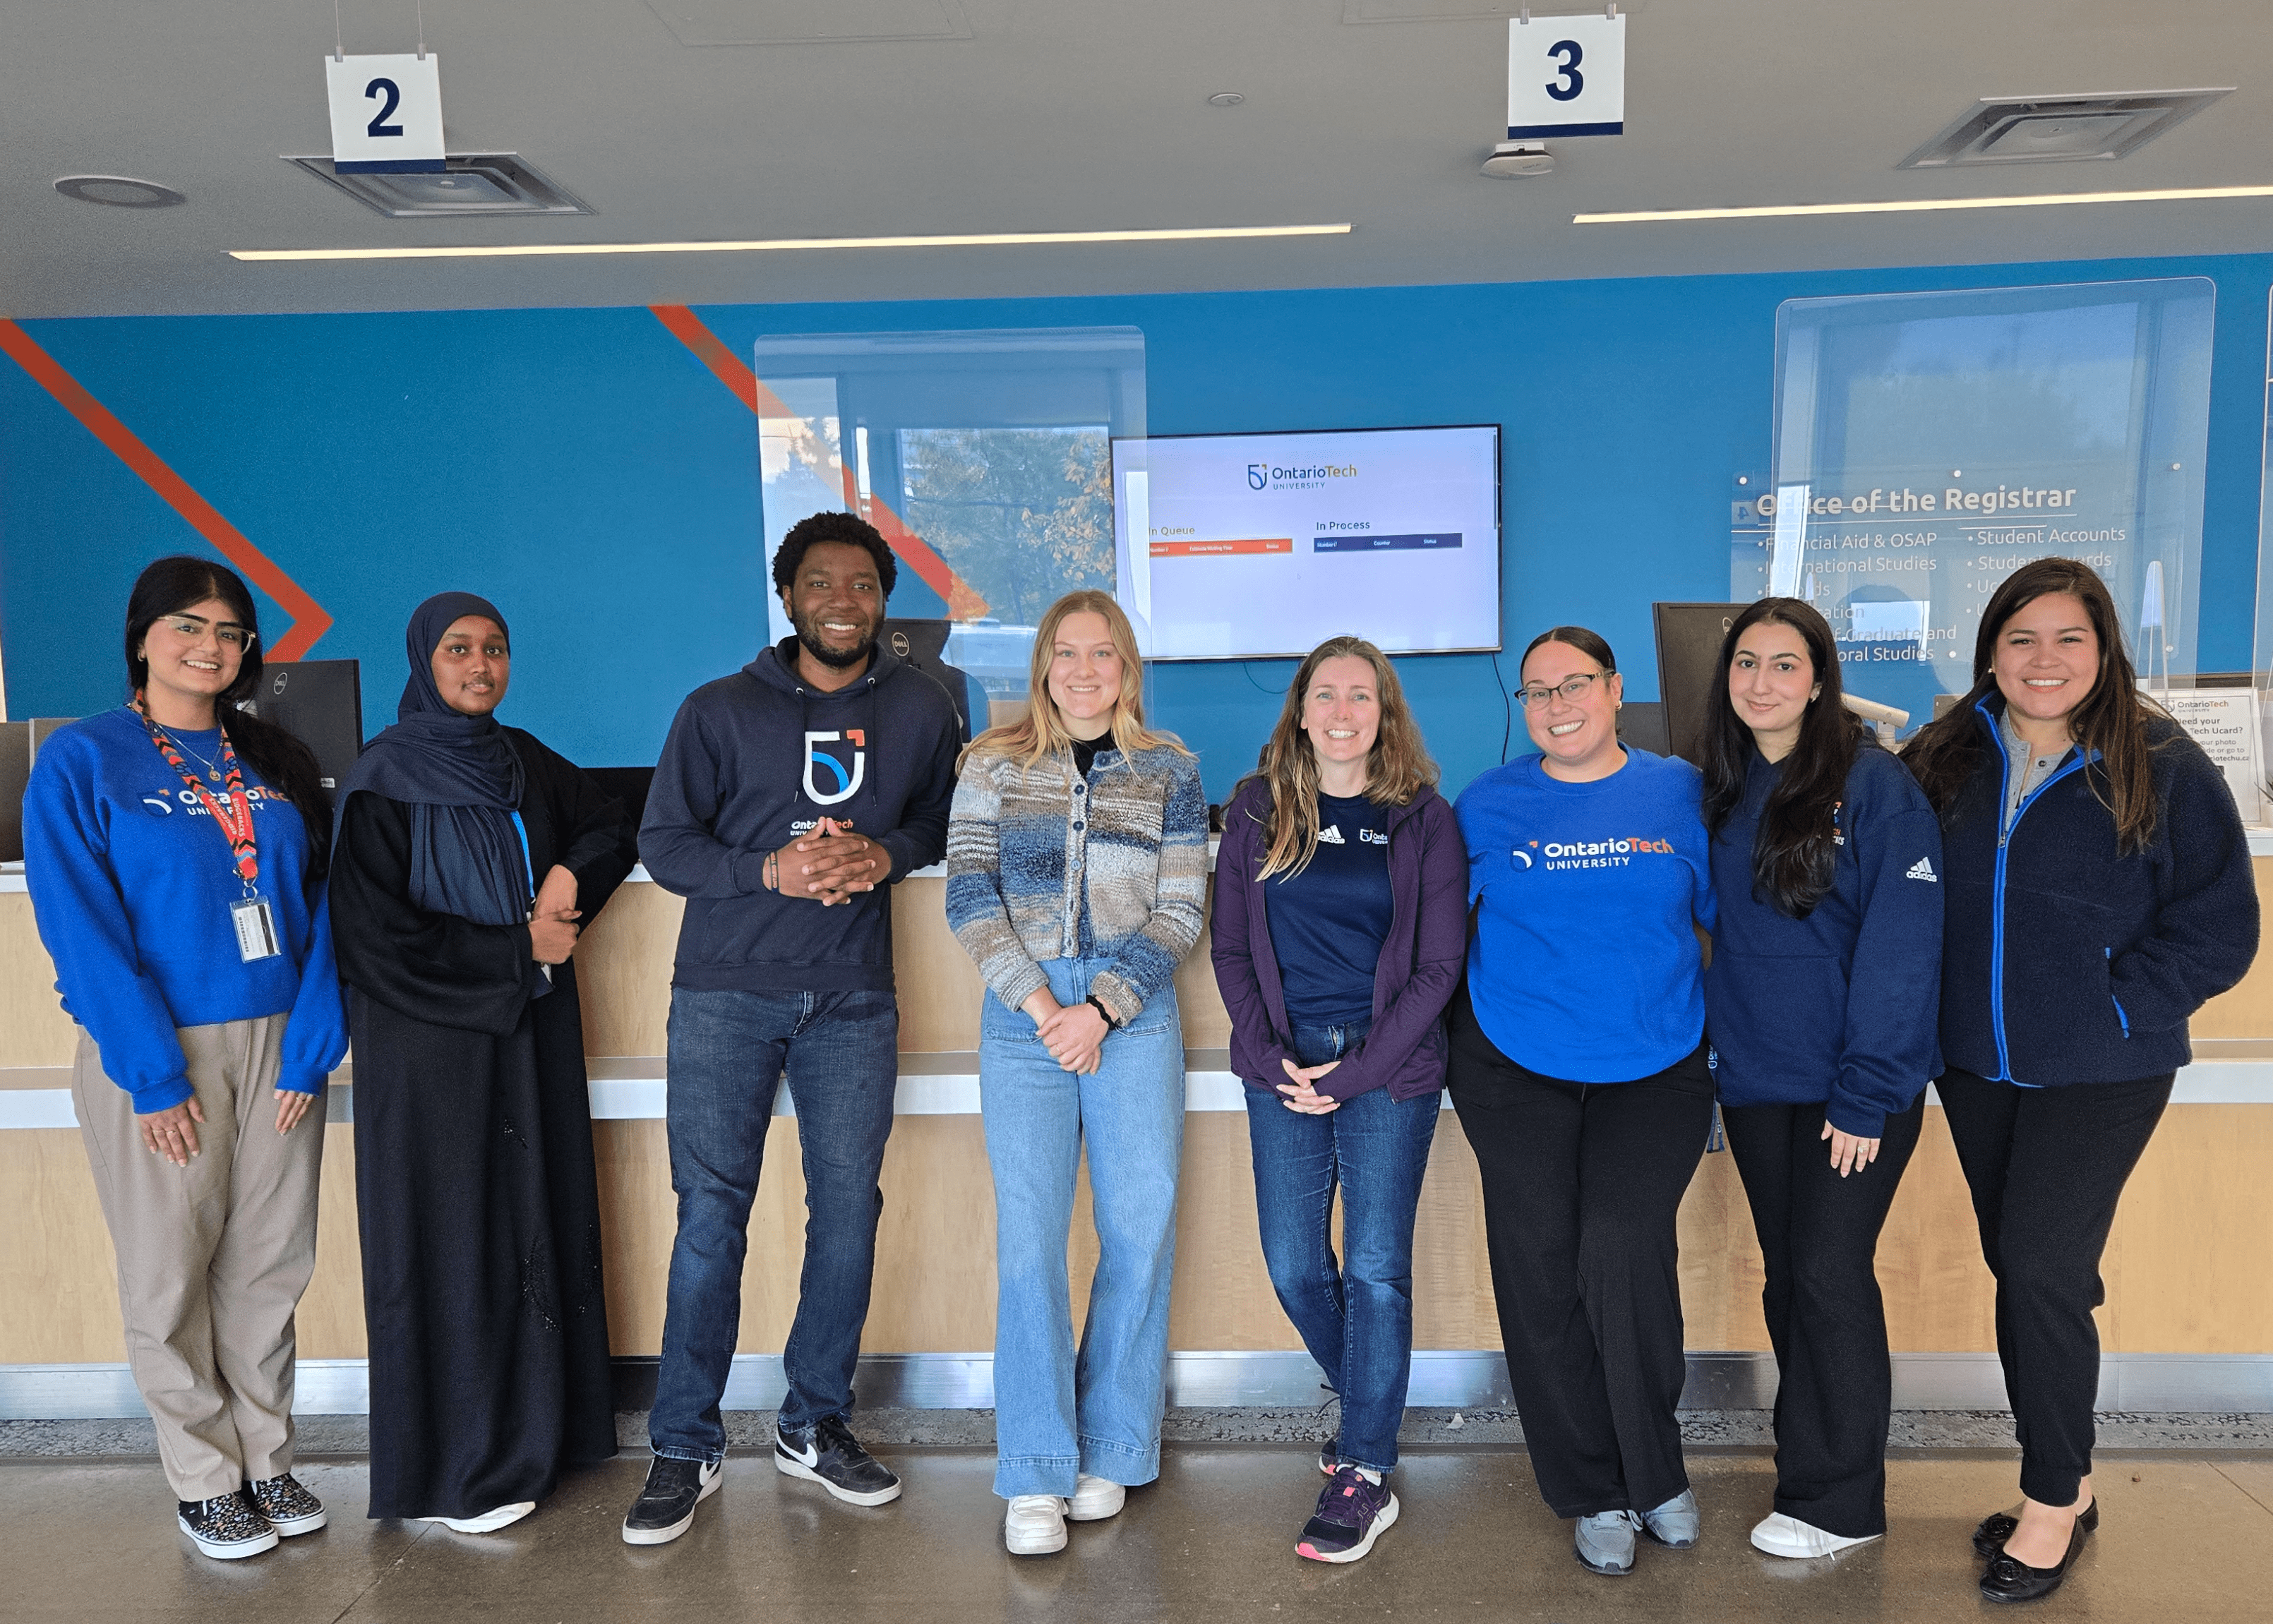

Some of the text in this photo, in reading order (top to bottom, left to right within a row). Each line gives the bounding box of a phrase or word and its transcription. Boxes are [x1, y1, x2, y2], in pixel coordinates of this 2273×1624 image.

[1545, 40, 1584, 101] 3
[364, 78, 403, 137] 2
[1272, 464, 1357, 479] OntarioTech
[1273, 482, 1326, 491] UNIVERSITY
[1851, 488, 1882, 514] of
[1890, 488, 1936, 512] the
[1945, 484, 2077, 514] Registrar
[1161, 527, 1195, 536] Queue
[1316, 521, 1370, 531] In Process
[1765, 532, 1937, 551] Fnancial Aid & OSAP
[1977, 527, 2126, 546] Student Accounts
[1876, 555, 1937, 572] Studies
[1846, 626, 1921, 643] Graduate
[1927, 625, 1957, 640] and
[1873, 646, 1934, 662] Studies
[232, 798, 246, 837] RIDGEBACKS
[1544, 838, 1674, 858] OntarioTech
[1546, 857, 1630, 870] UNIVERSITY
[1906, 871, 1937, 882] adidas
